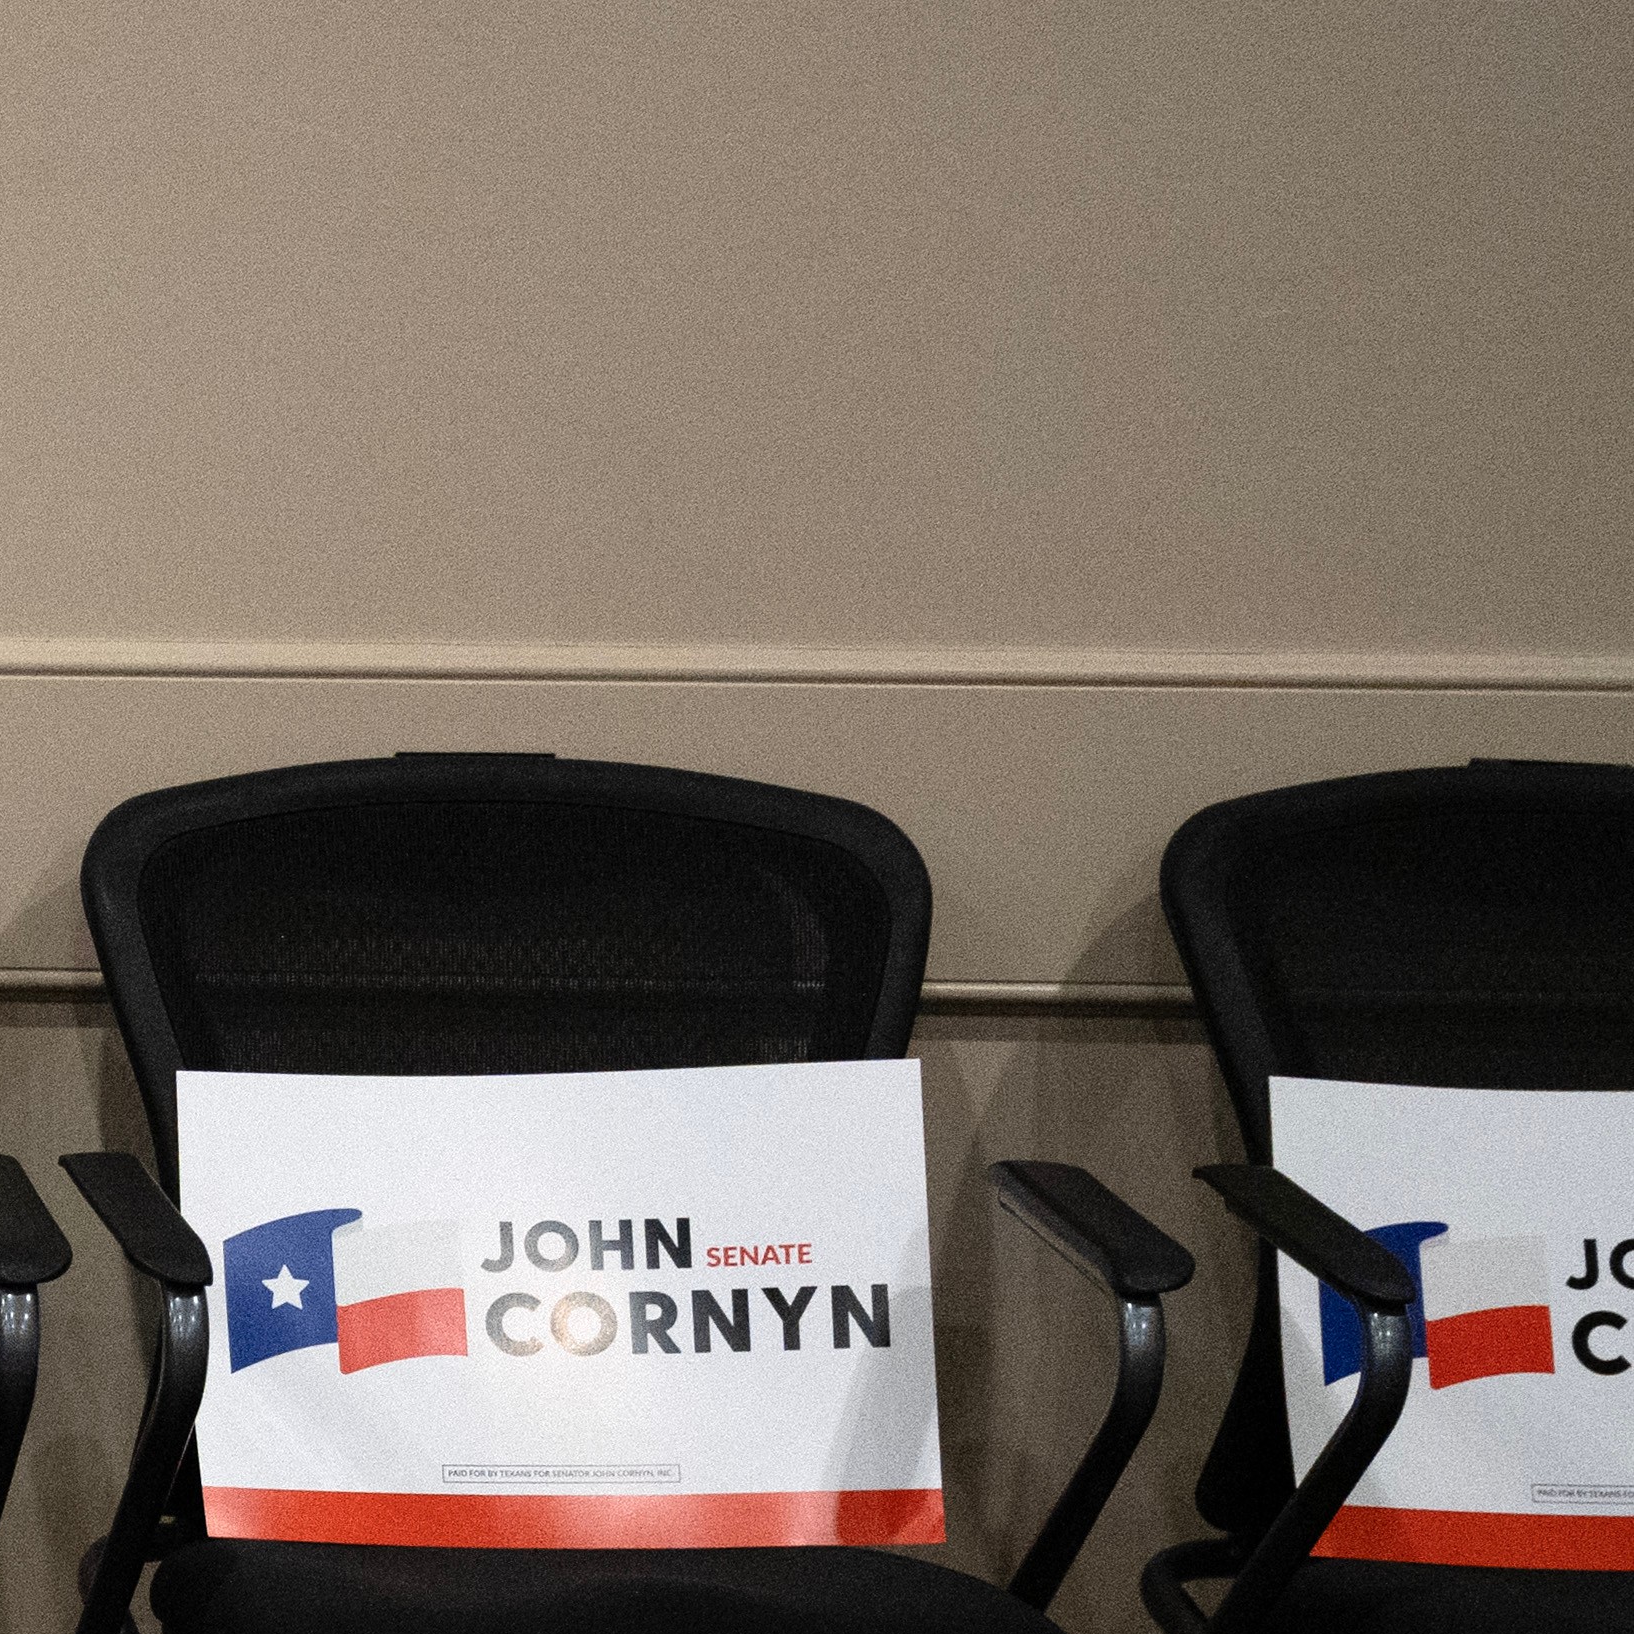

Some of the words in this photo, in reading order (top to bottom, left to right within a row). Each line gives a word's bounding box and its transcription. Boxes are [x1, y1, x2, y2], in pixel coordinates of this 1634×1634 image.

[480, 1217, 693, 1274] JOHN
[705, 1242, 813, 1268] SENATE
[484, 1283, 891, 1357] CORNYN
